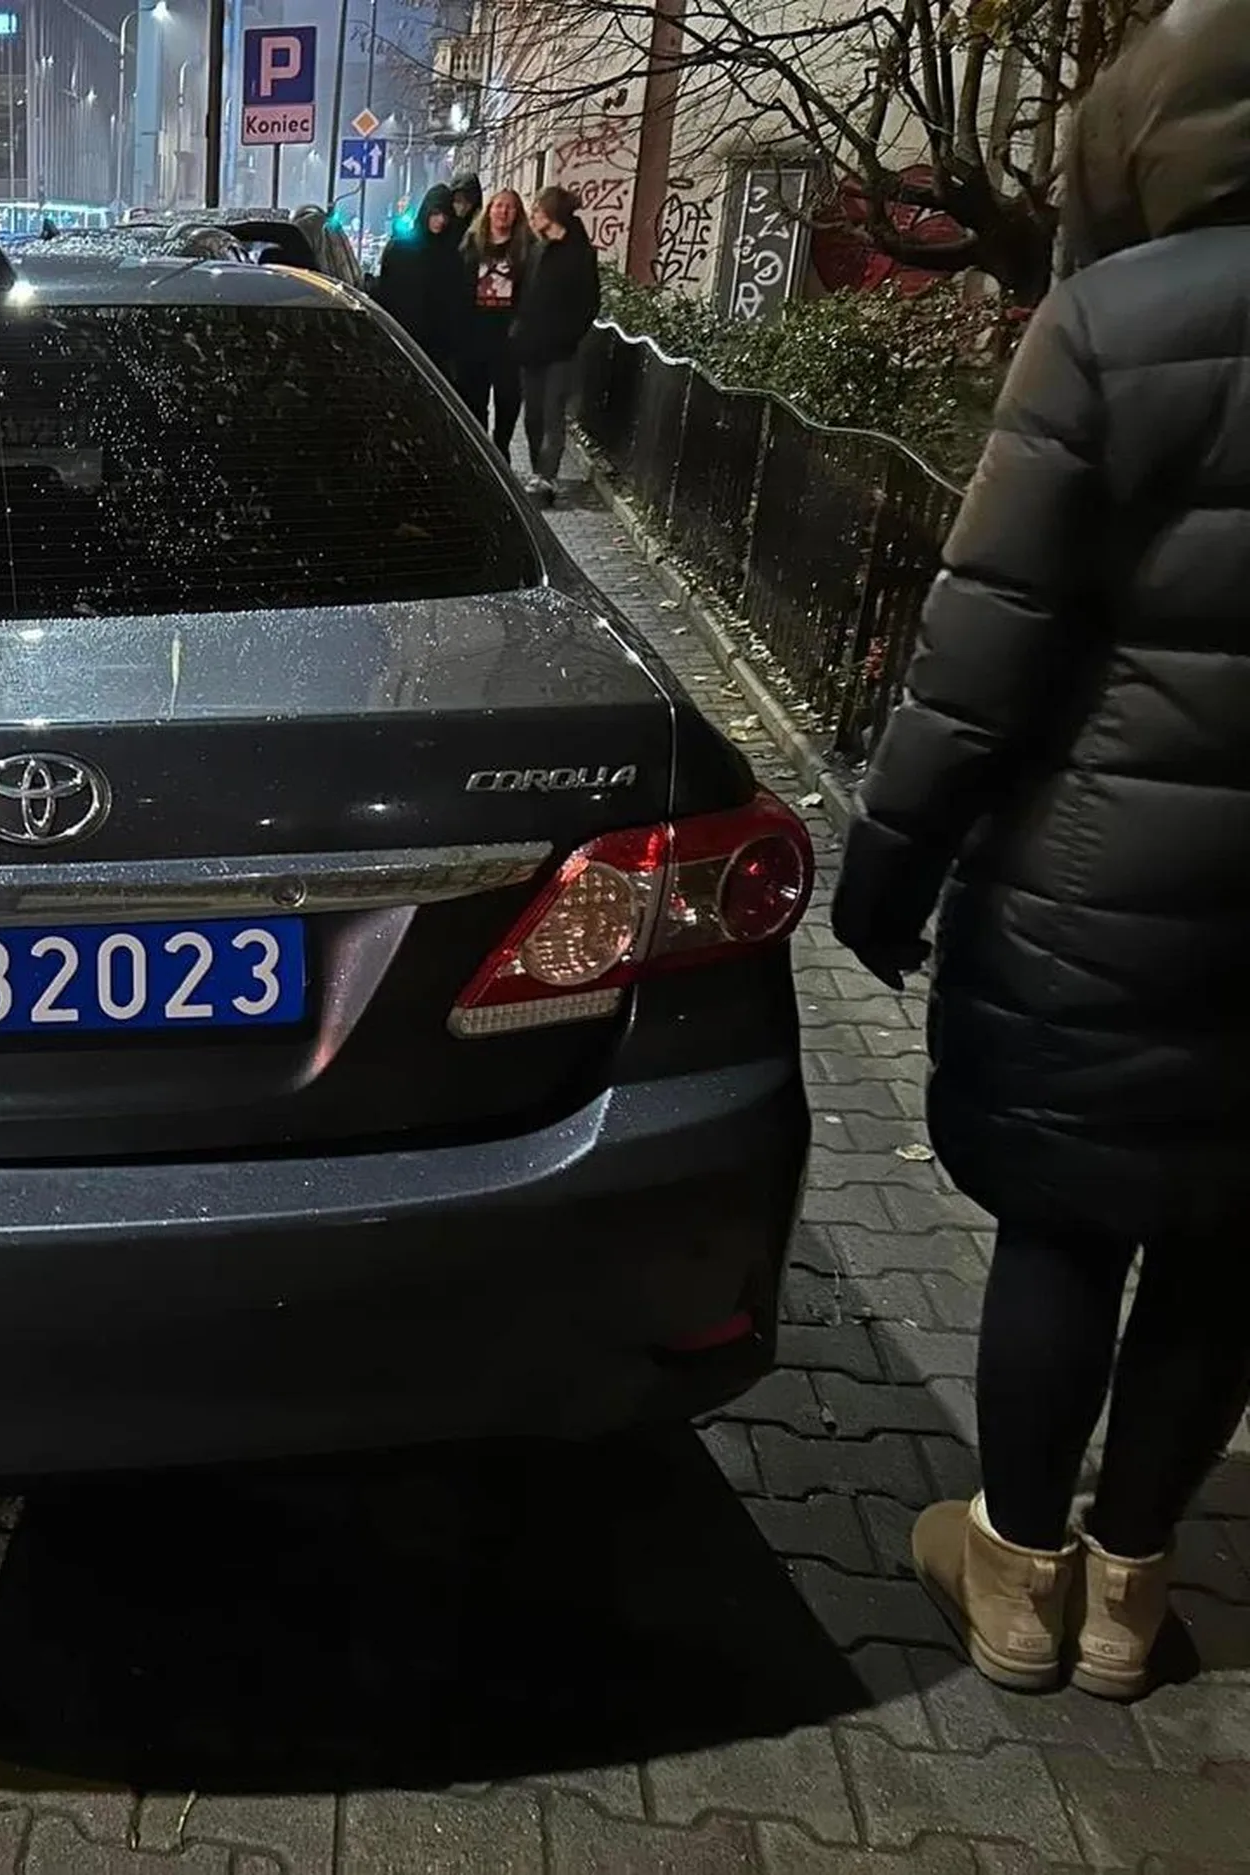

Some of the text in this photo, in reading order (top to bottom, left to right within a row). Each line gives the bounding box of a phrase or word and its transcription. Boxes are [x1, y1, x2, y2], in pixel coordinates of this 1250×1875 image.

[260, 35, 302, 97] P
[246, 114, 310, 134] Koniec
[465, 765, 638, 792] COROLLA
